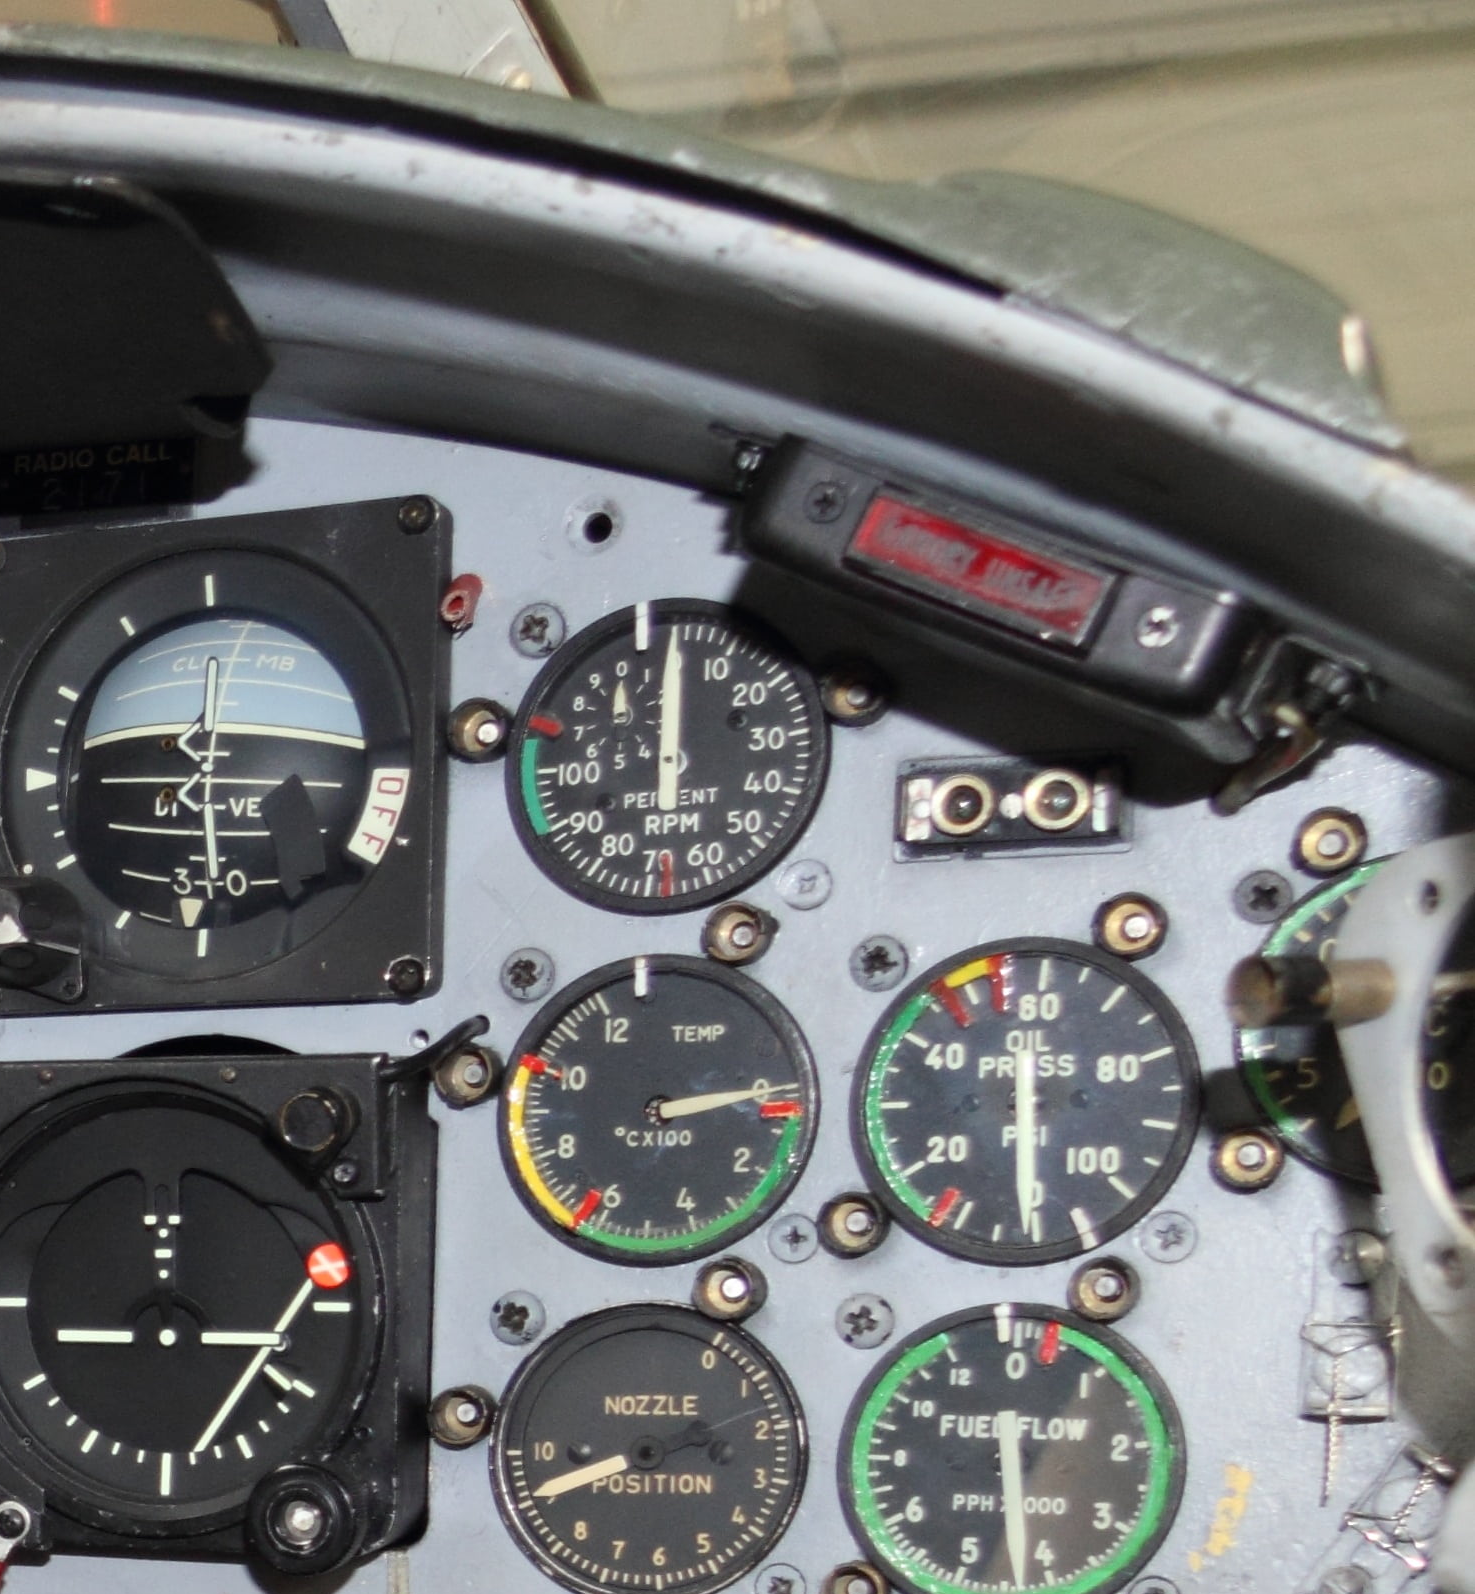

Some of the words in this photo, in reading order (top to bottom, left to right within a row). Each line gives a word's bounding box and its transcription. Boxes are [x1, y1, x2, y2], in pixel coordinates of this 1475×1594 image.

[645, 815, 700, 834] RPM
[672, 1026, 725, 1042] TEMP
[925, 1044, 964, 1069] 40
[927, 1137, 967, 1162] 20
[1067, 1147, 1119, 1174] 100
[605, 1396, 698, 1415] NOZZLE
[1017, 1419, 1087, 1441] FLOW
[952, 1495, 994, 1511] PPH
